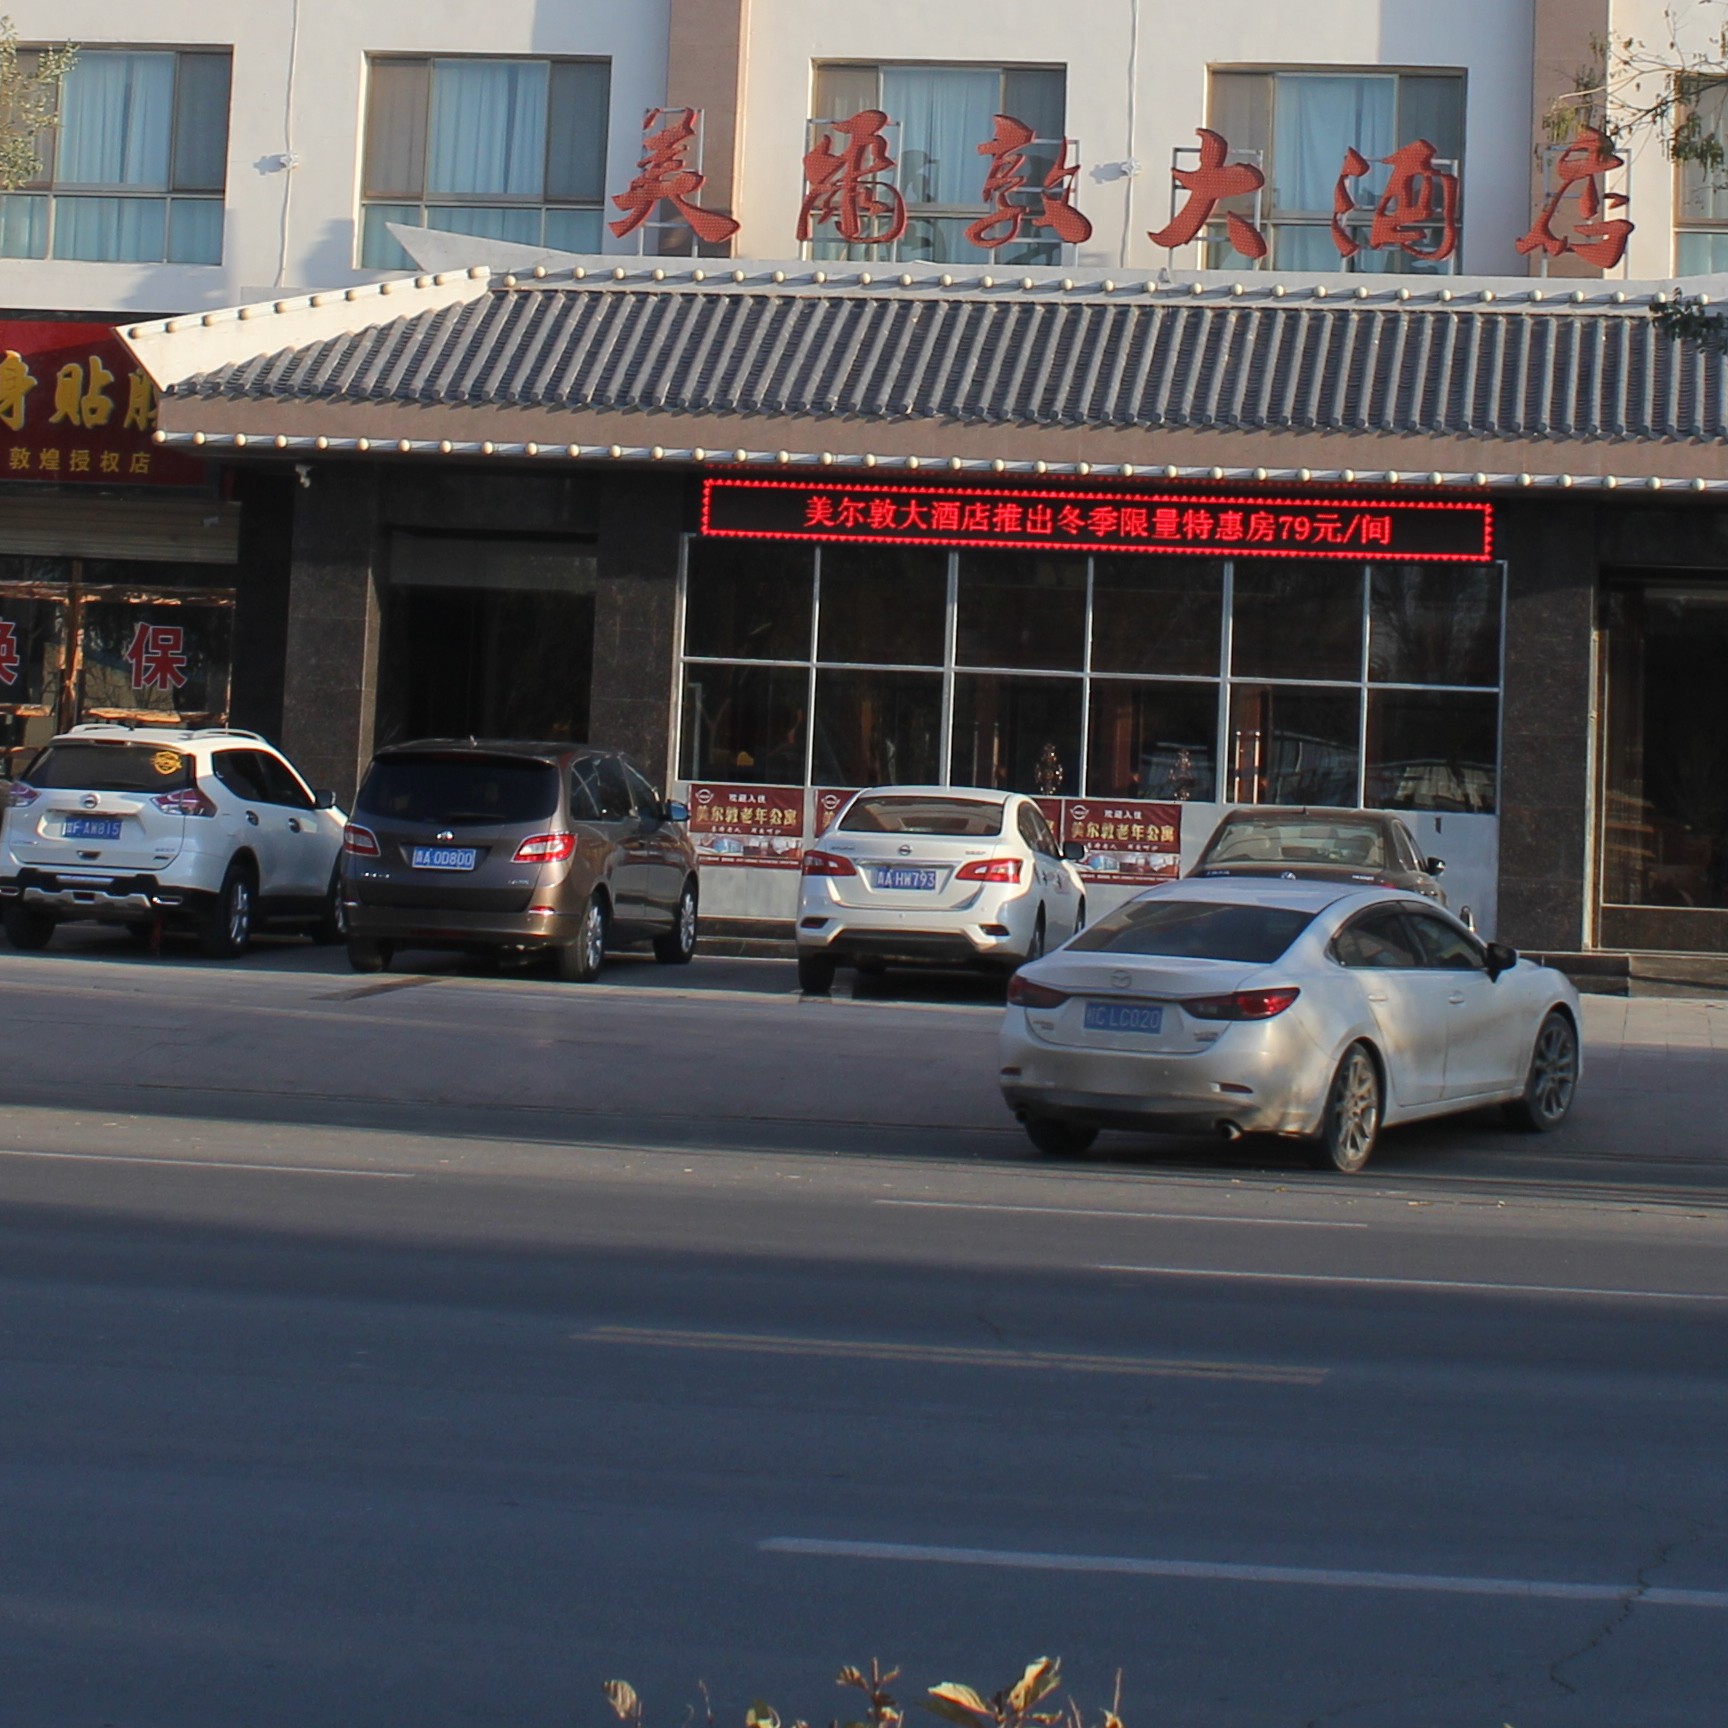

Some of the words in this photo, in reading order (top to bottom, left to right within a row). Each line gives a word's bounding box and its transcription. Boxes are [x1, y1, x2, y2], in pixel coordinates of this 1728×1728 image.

[9, 447, 151, 473] 敦煌授权店
[803, 495, 1392, 546] 美尔敦大酒店推出冬季限量特惠房79元/间
[127, 622, 188, 691] 保
[696, 805, 797, 826] 美尔敦老年公寓
[1072, 821, 1174, 842] 美尔敦老年公寓
